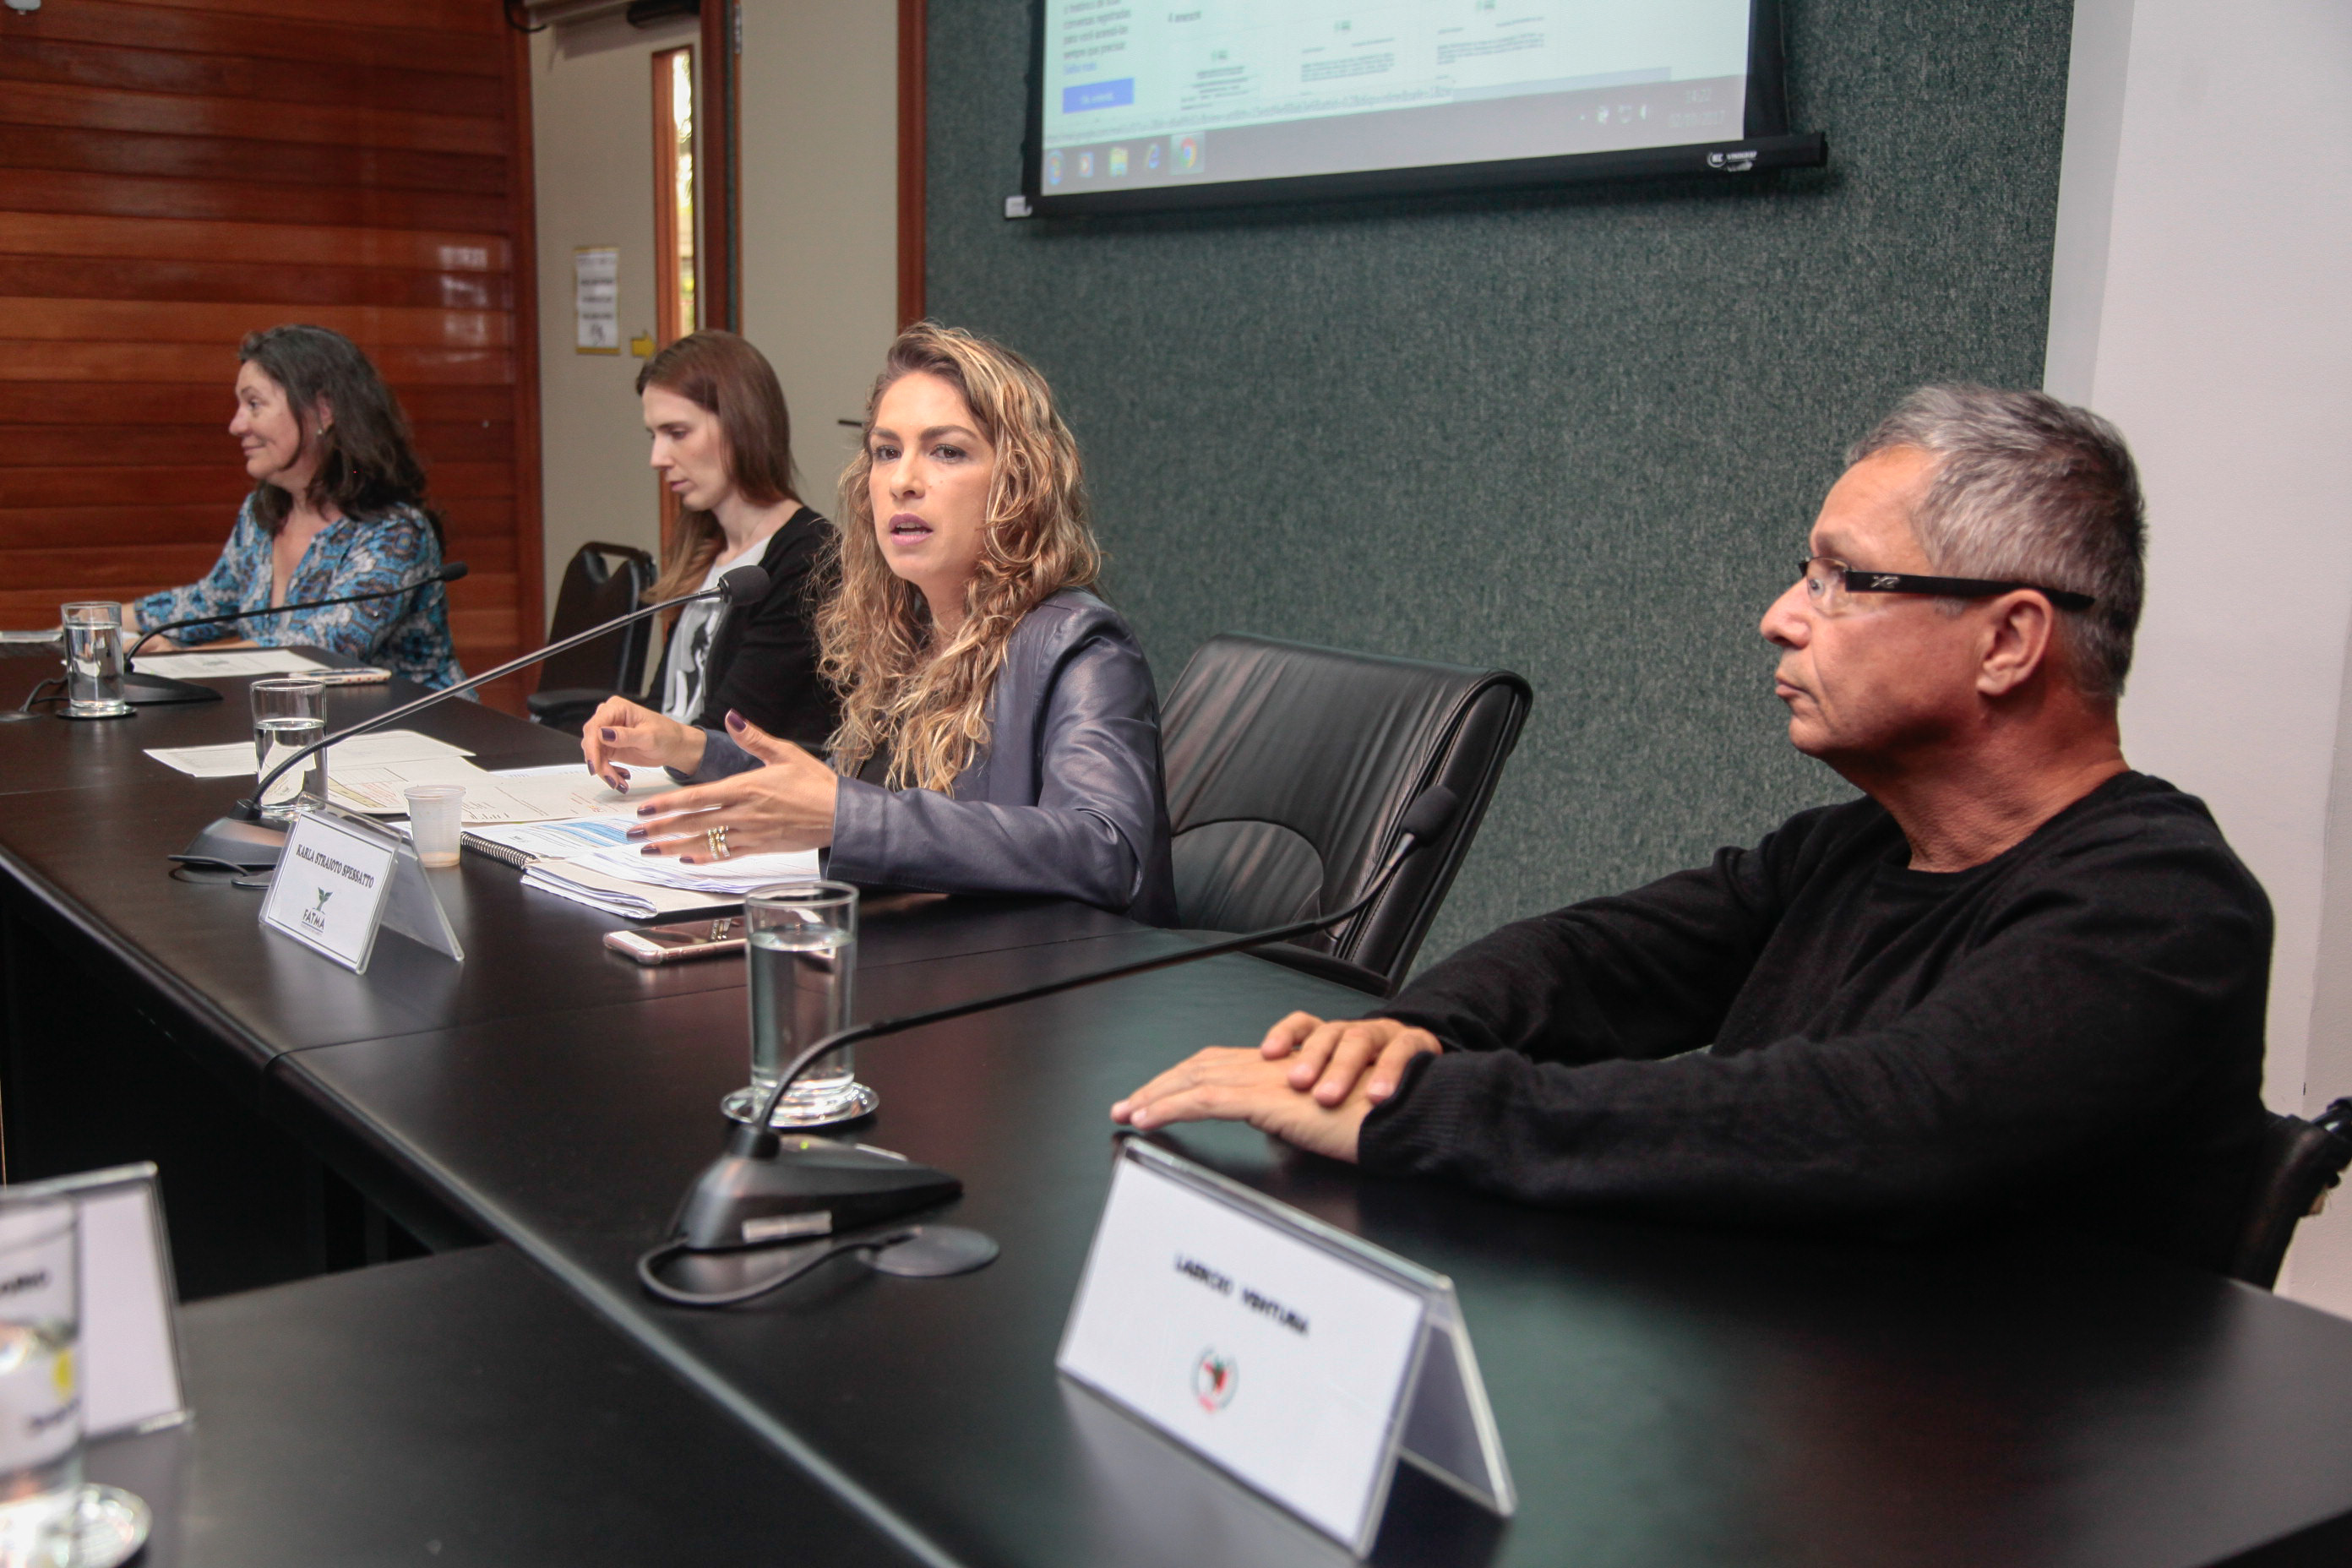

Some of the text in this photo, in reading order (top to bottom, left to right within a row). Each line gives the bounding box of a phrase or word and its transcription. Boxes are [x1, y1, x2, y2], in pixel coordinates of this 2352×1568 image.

[297, 844, 373, 888] KARLA STRAIOTO SPESSATTO
[302, 908, 325, 930] FATMA
[1243, 1288, 1309, 1334] VENTURA
